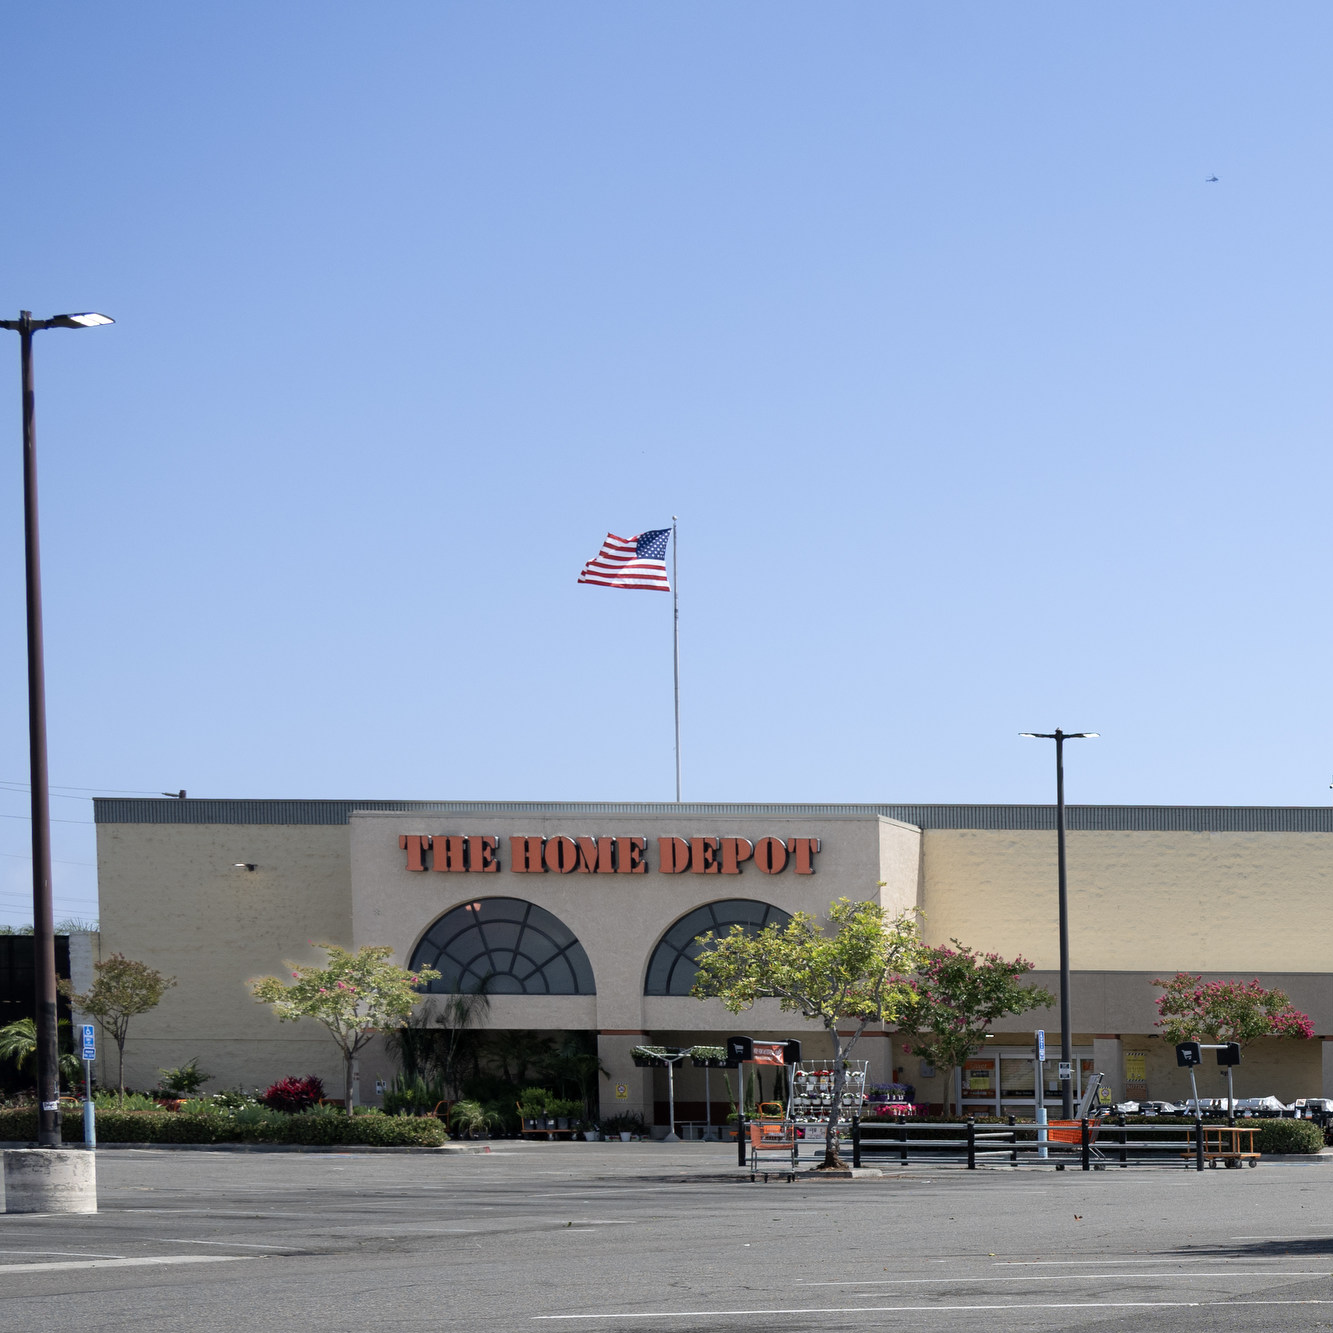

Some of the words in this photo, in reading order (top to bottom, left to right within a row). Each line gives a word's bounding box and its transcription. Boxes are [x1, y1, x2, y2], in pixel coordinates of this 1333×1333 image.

[399, 835, 499, 873] THE
[509, 836, 648, 874] HOME
[659, 837, 820, 874] DEPOT
